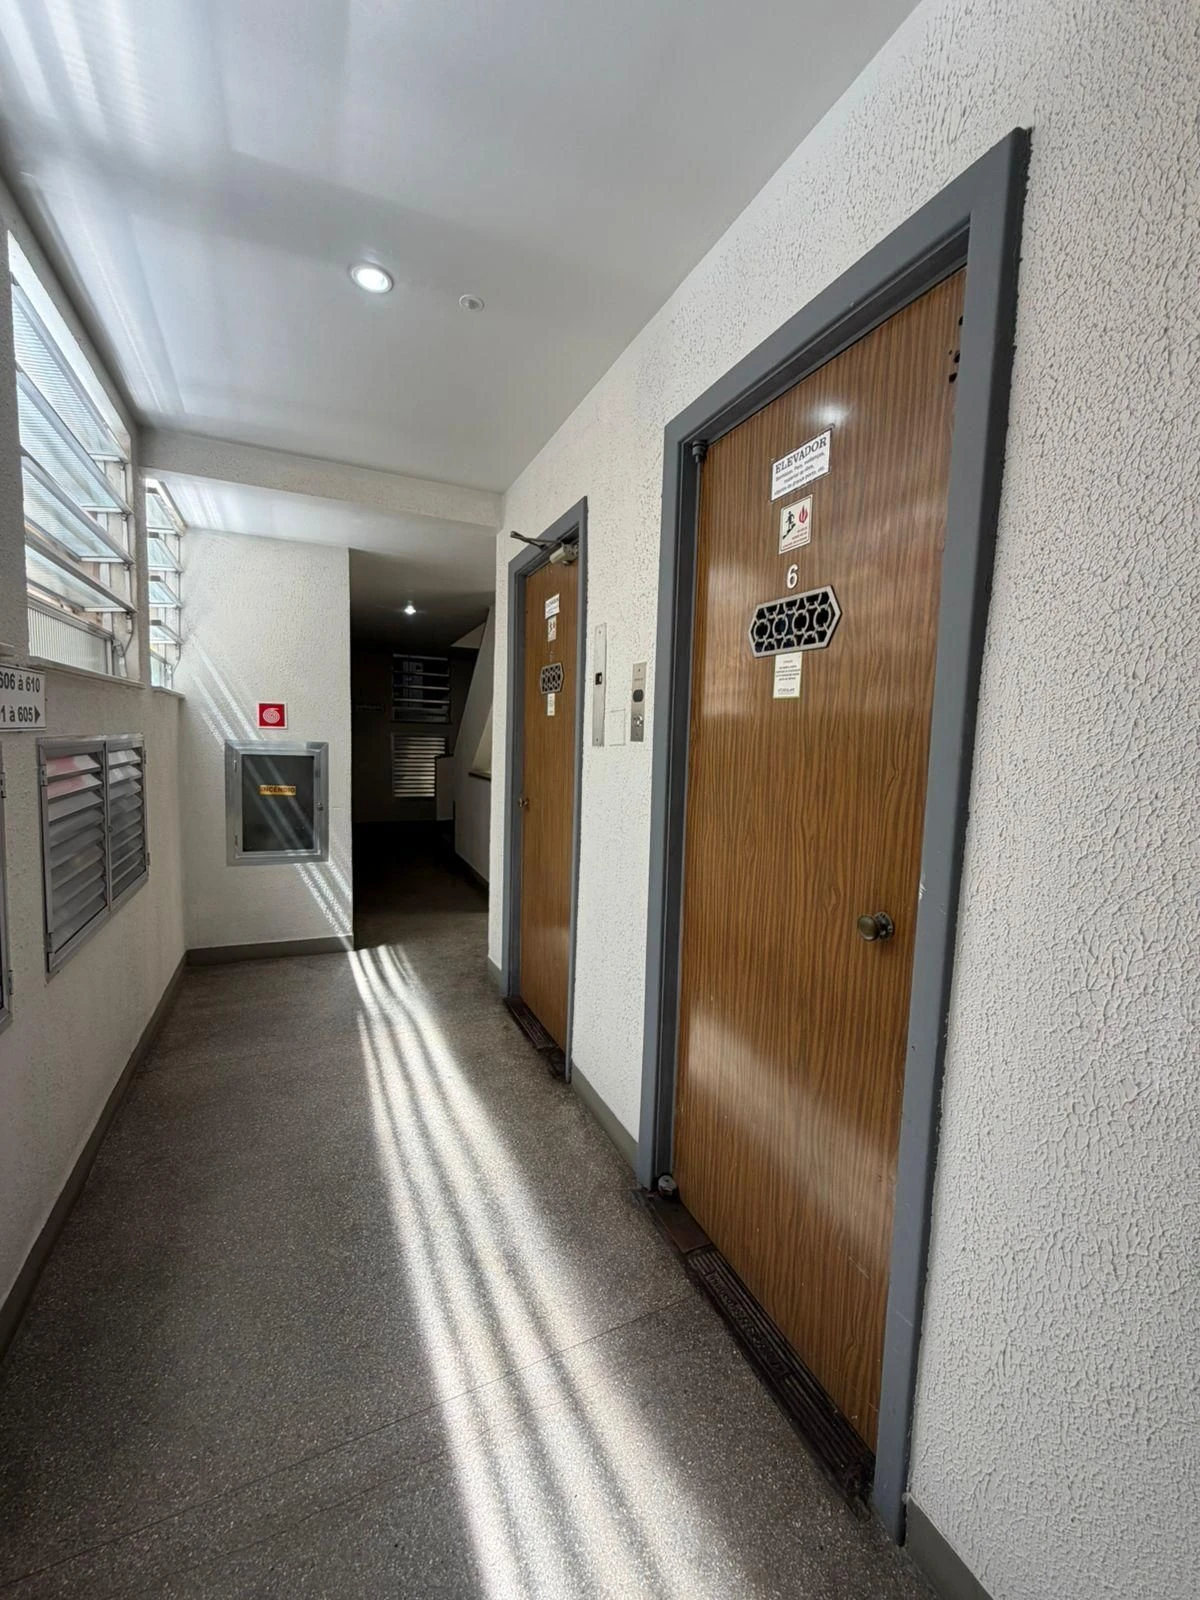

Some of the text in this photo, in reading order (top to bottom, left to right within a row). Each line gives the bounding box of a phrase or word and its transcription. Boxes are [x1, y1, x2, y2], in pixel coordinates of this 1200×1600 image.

[775, 437, 827, 474] ELEVADOR
[787, 564, 798, 589] 6
[26, 676, 40, 693] 610
[18, 706, 33, 722] 605
